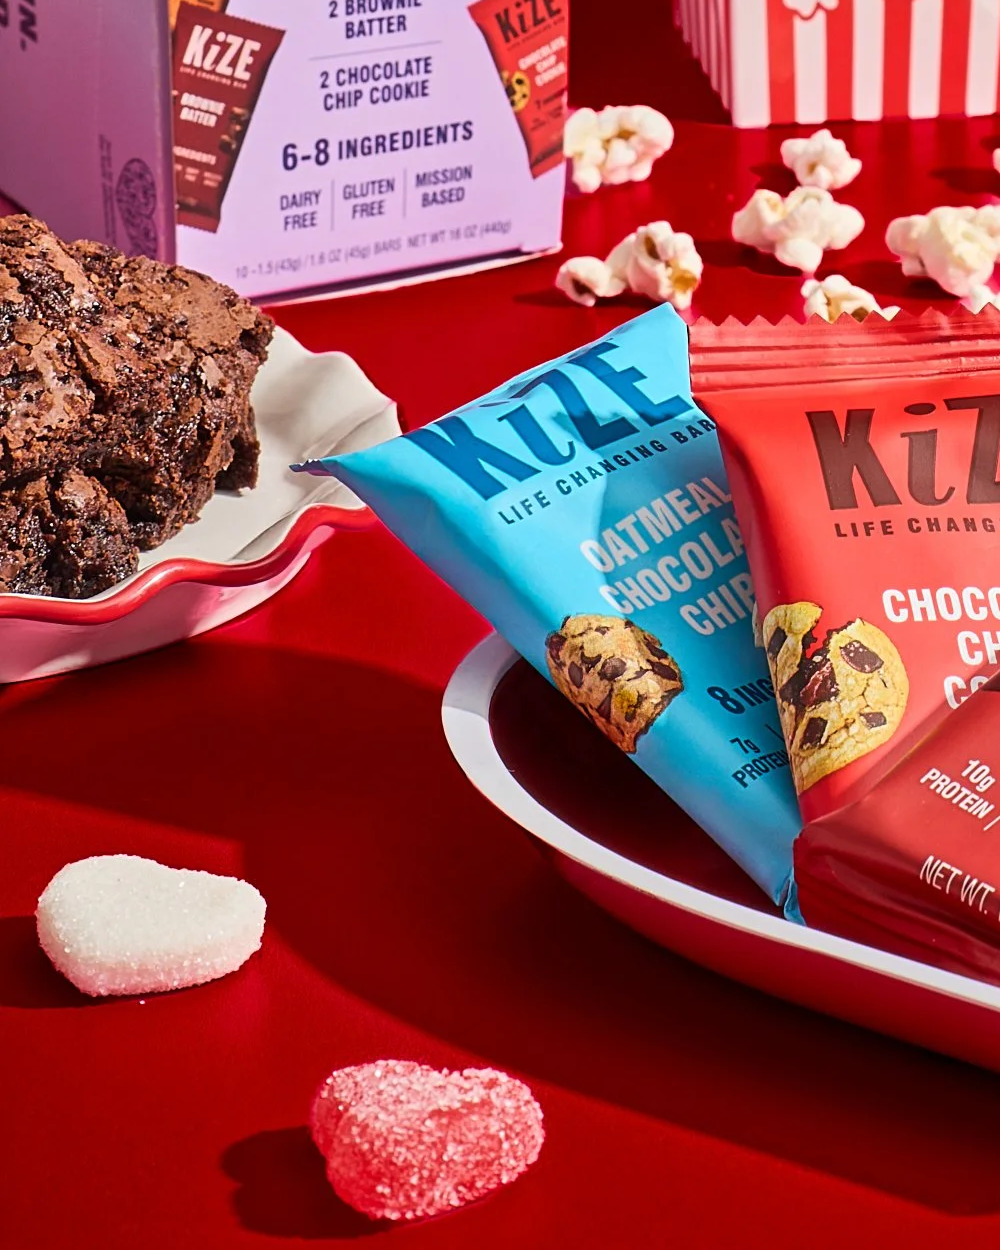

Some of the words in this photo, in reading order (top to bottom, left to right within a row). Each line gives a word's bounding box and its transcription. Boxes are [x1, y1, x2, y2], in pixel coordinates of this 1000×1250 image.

[329, 0, 338, 18] 2
[345, 15, 407, 39] BATTER
[183, 25, 262, 81] KiZE
[320, 71, 329, 89] 2
[336, 56, 432, 86] CHOCOLATE
[323, 89, 363, 111] CHIP
[370, 79, 429, 104] COOKIE
[282, 138, 330, 171] 6-8
[338, 120, 473, 161] INGREDIENTS
[343, 178, 395, 200] GLUTEN
[415, 165, 473, 188] MISSION
[280, 190, 321, 211] DAIRY
[352, 201, 385, 220] FREE
[421, 187, 466, 208] BASED
[284, 212, 318, 231] FREE
[497, 490, 551, 525] LIFE
[555, 439, 668, 496] CHANGING
[670, 418, 717, 444] BAR
[580, 477, 732, 574] OATMEAL
[834, 519, 894, 539] LIFE
[706, 686, 746, 715] 8
[729, 737, 761, 754] 7g
[960, 758, 997, 793] 10g
[919, 767, 995, 820] PROTEIN
[919, 855, 962, 894] NET
[960, 875, 995, 915] WT.
